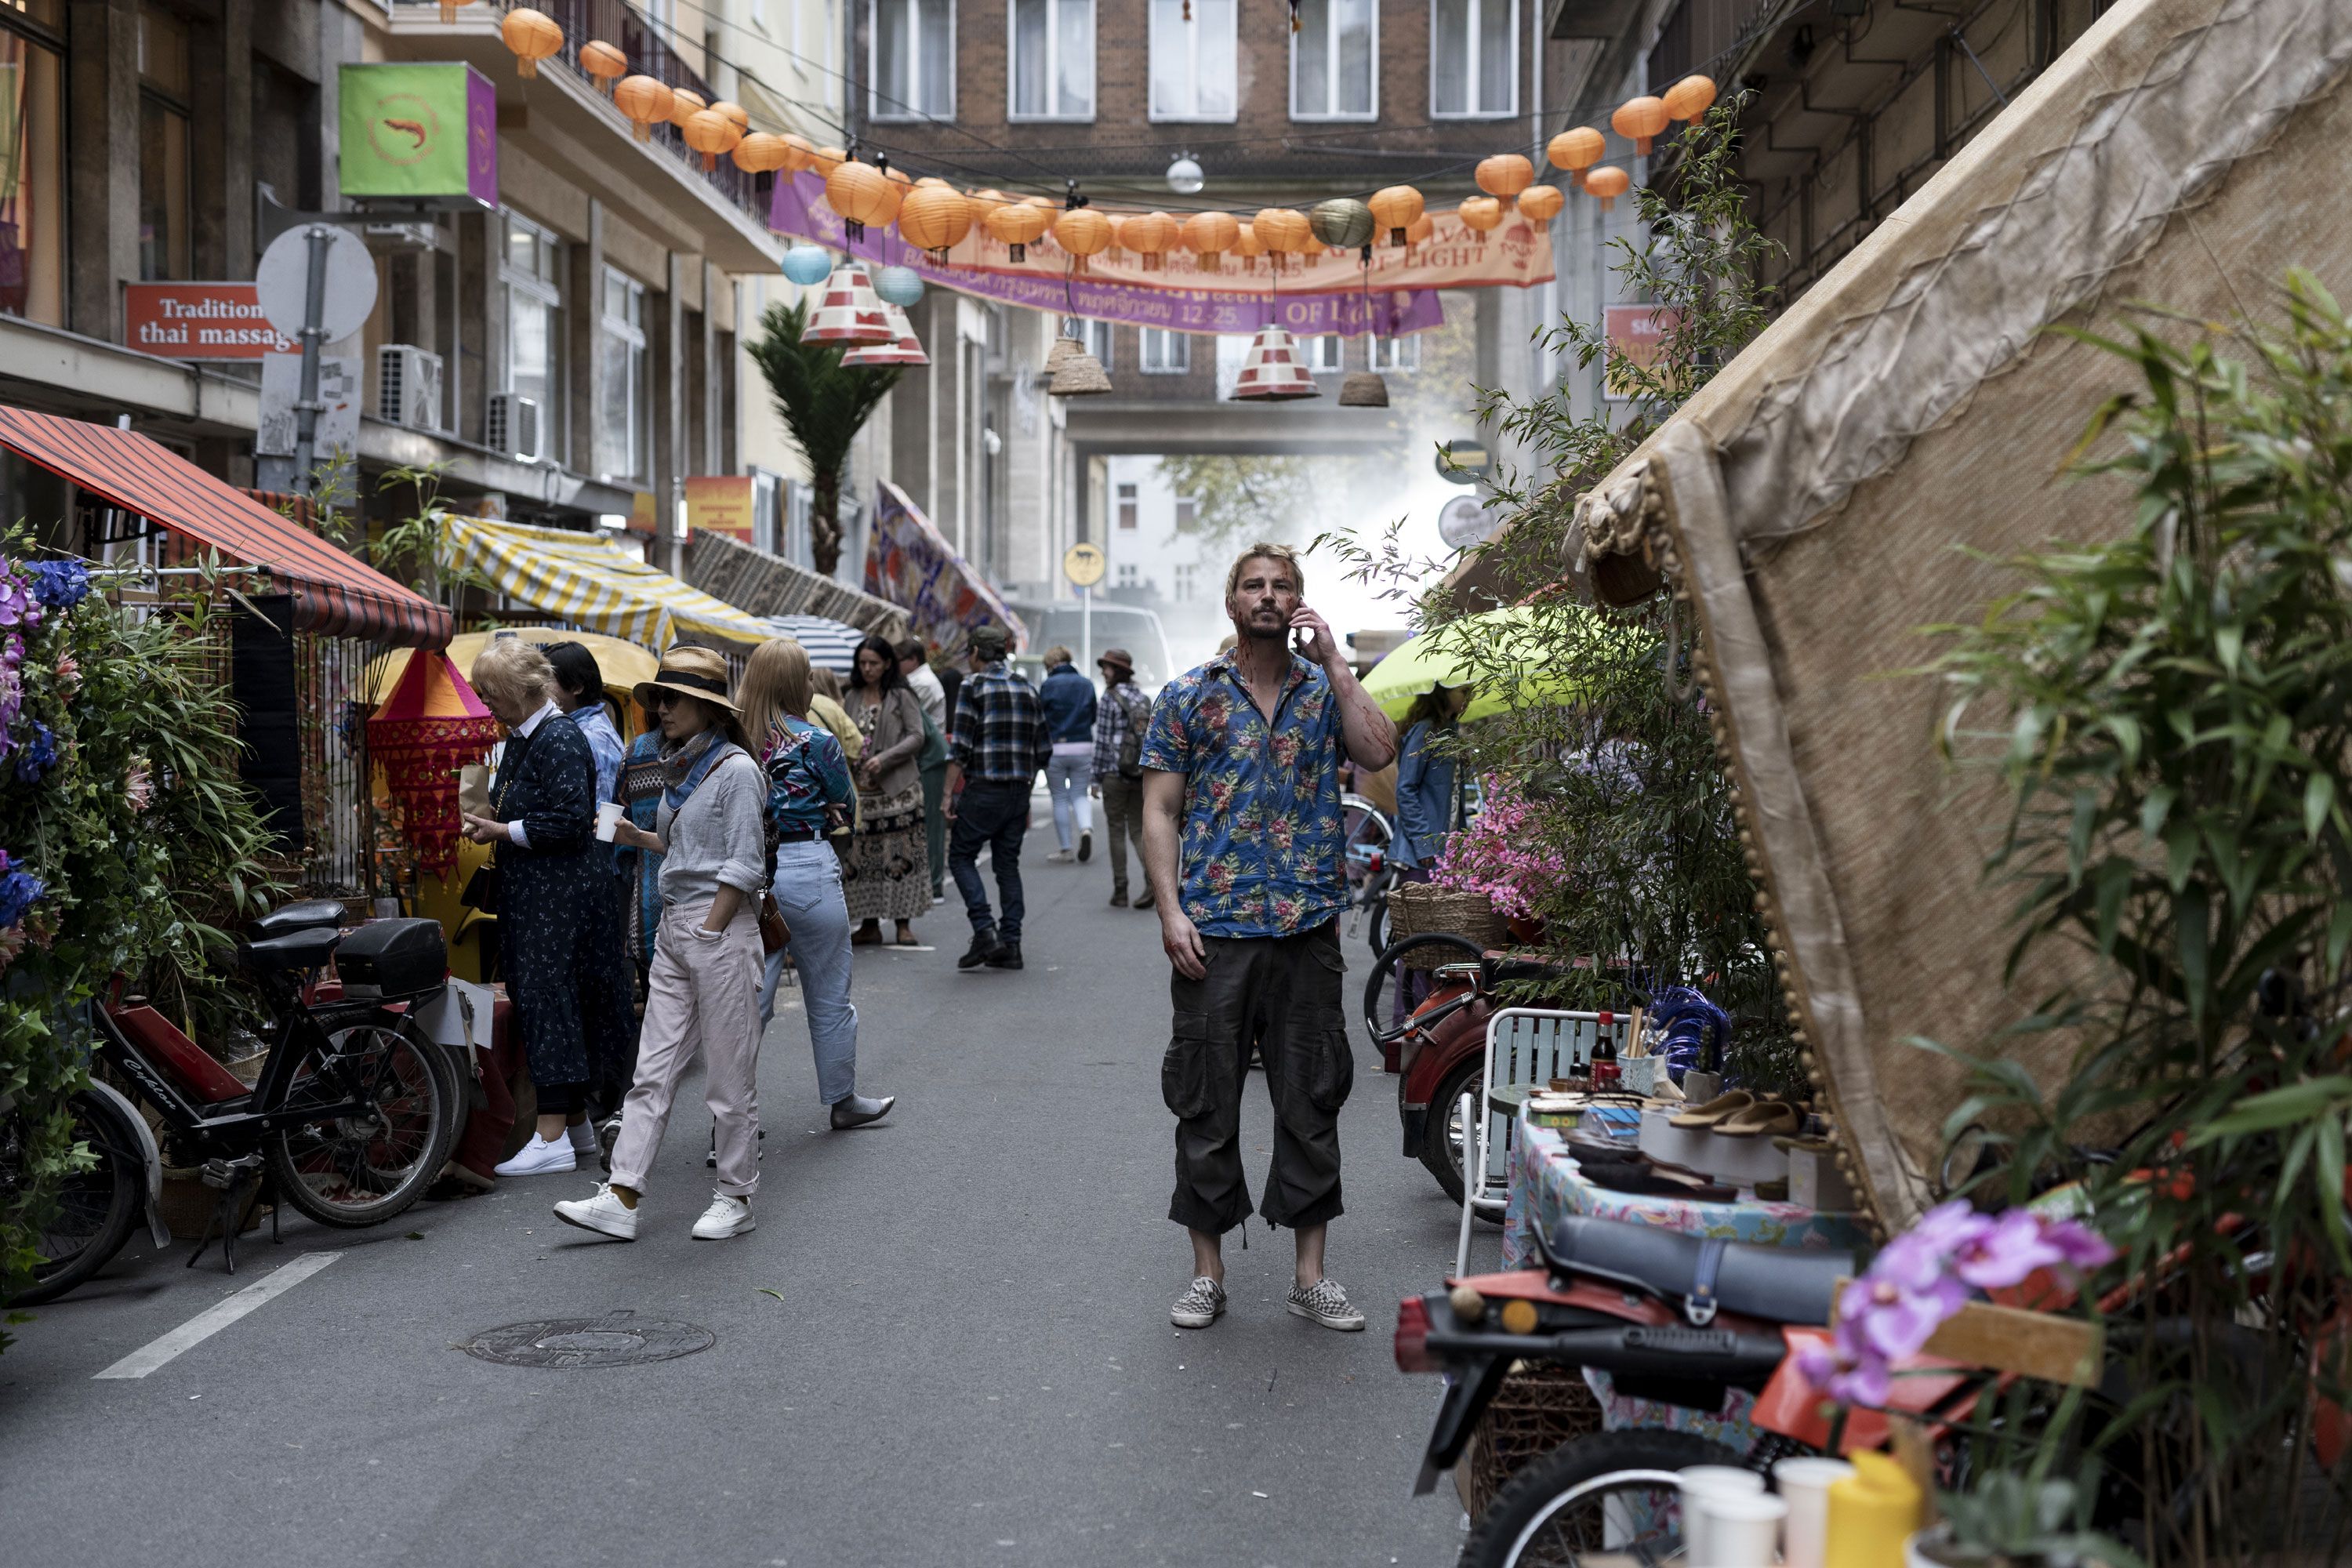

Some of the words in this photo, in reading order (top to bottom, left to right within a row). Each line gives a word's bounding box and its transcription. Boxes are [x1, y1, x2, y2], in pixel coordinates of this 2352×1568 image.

[1404, 246, 1489, 269] LIGHT
[159, 298, 264, 318] Tradition
[1286, 301, 1323, 324] OF
[140, 321, 189, 344] thai
[198, 328, 299, 353] massag
[123, 1059, 176, 1109] Cyklon
